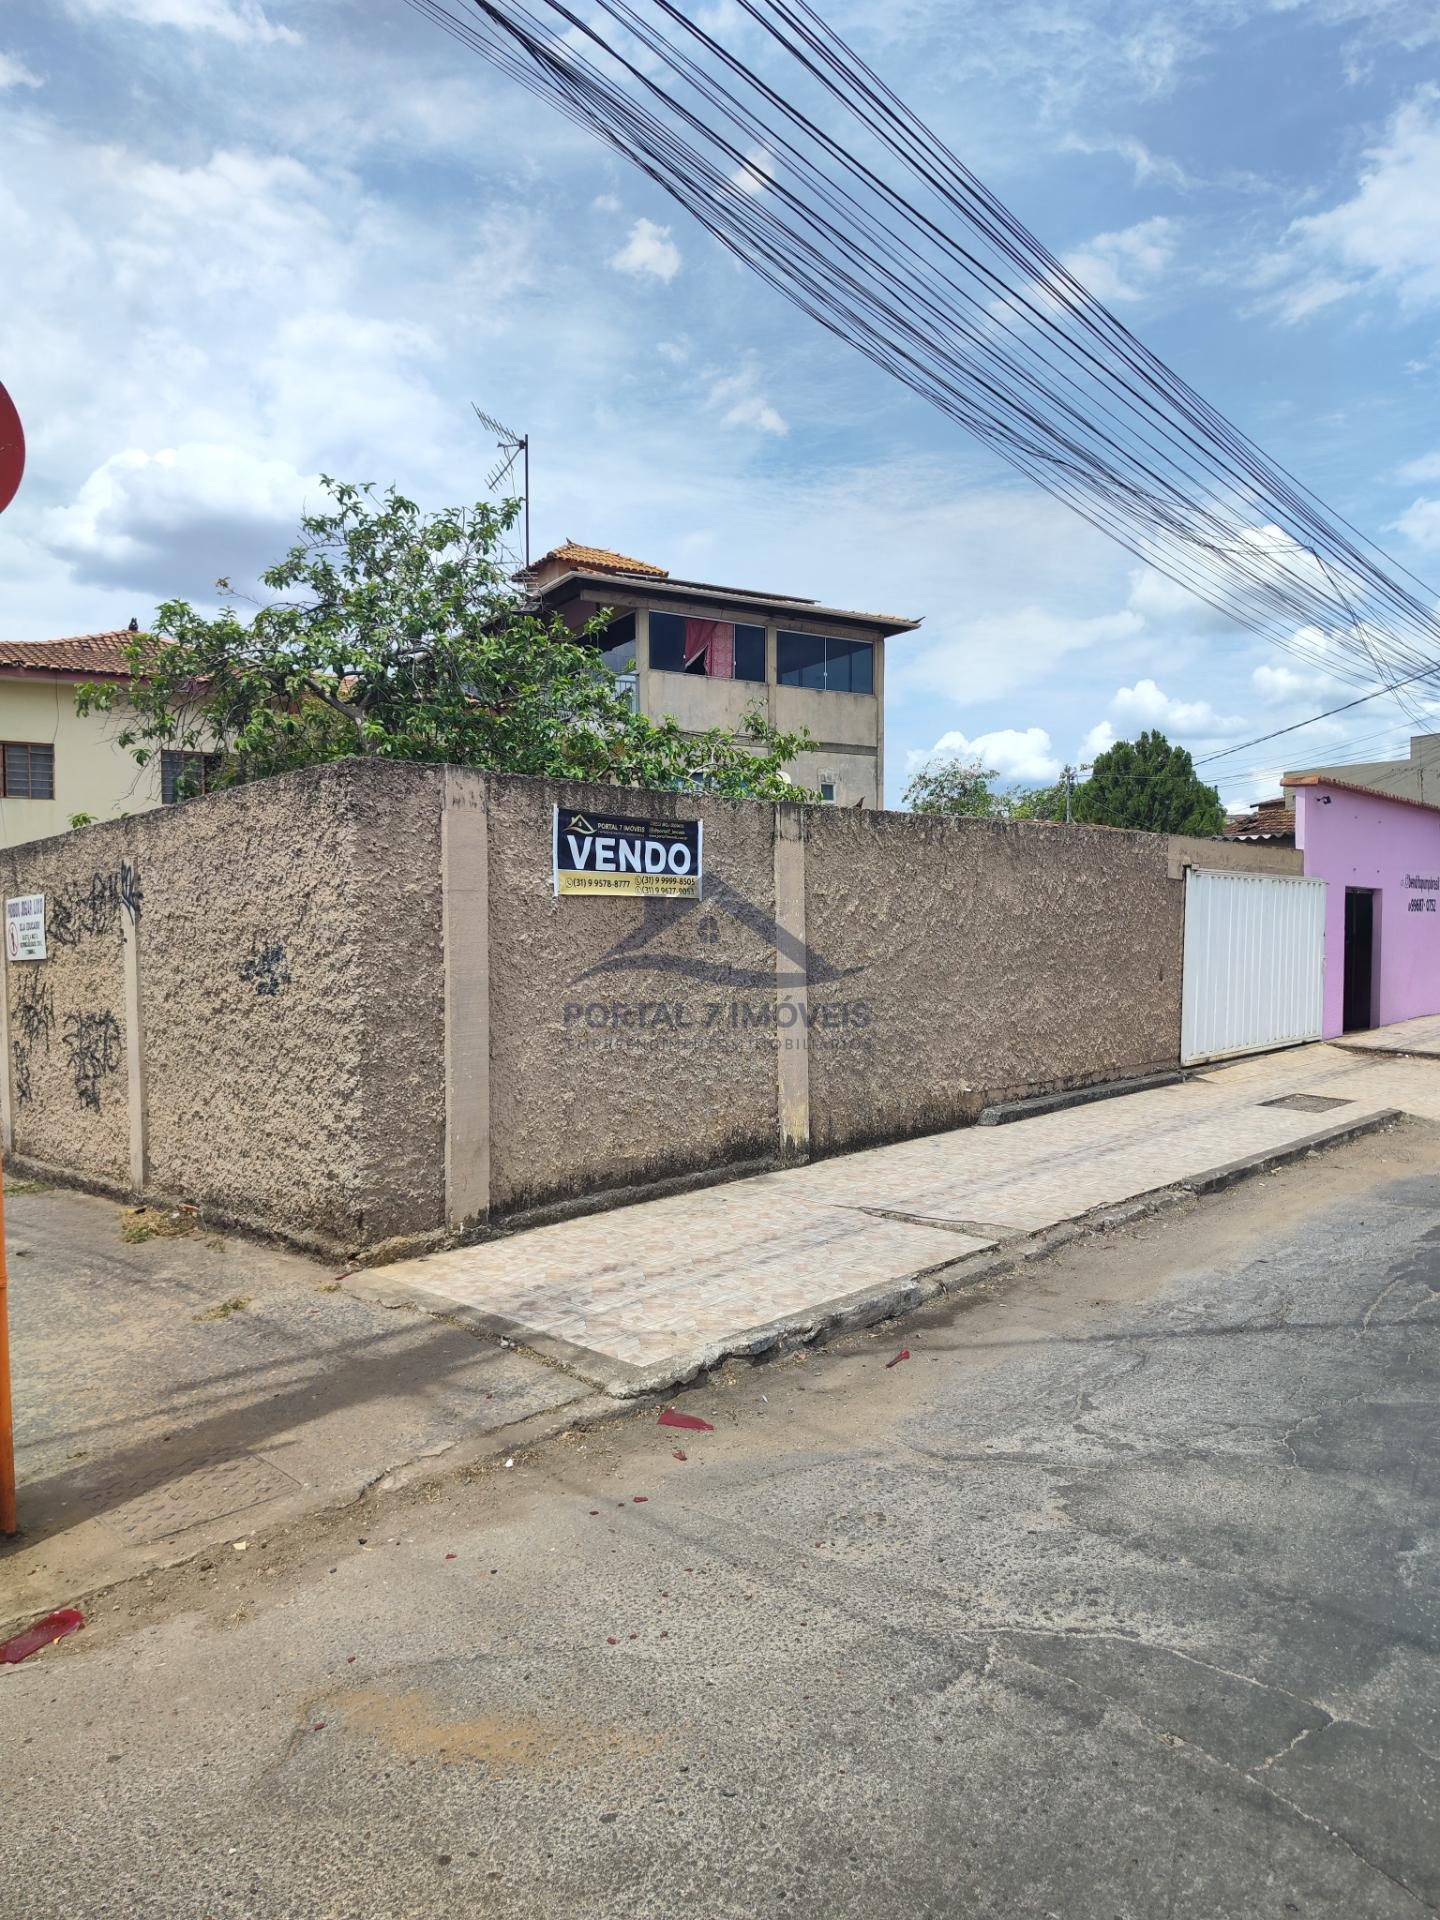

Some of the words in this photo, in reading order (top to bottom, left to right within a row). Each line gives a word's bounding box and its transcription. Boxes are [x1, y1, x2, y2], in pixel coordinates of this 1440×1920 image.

[597, 822, 618, 832] PORTAL
[567, 835, 691, 875] VENDO
[573, 879, 587, 888] (31)
[594, 880, 630, 889] 9578-8777
[641, 876, 654, 885] (31)
